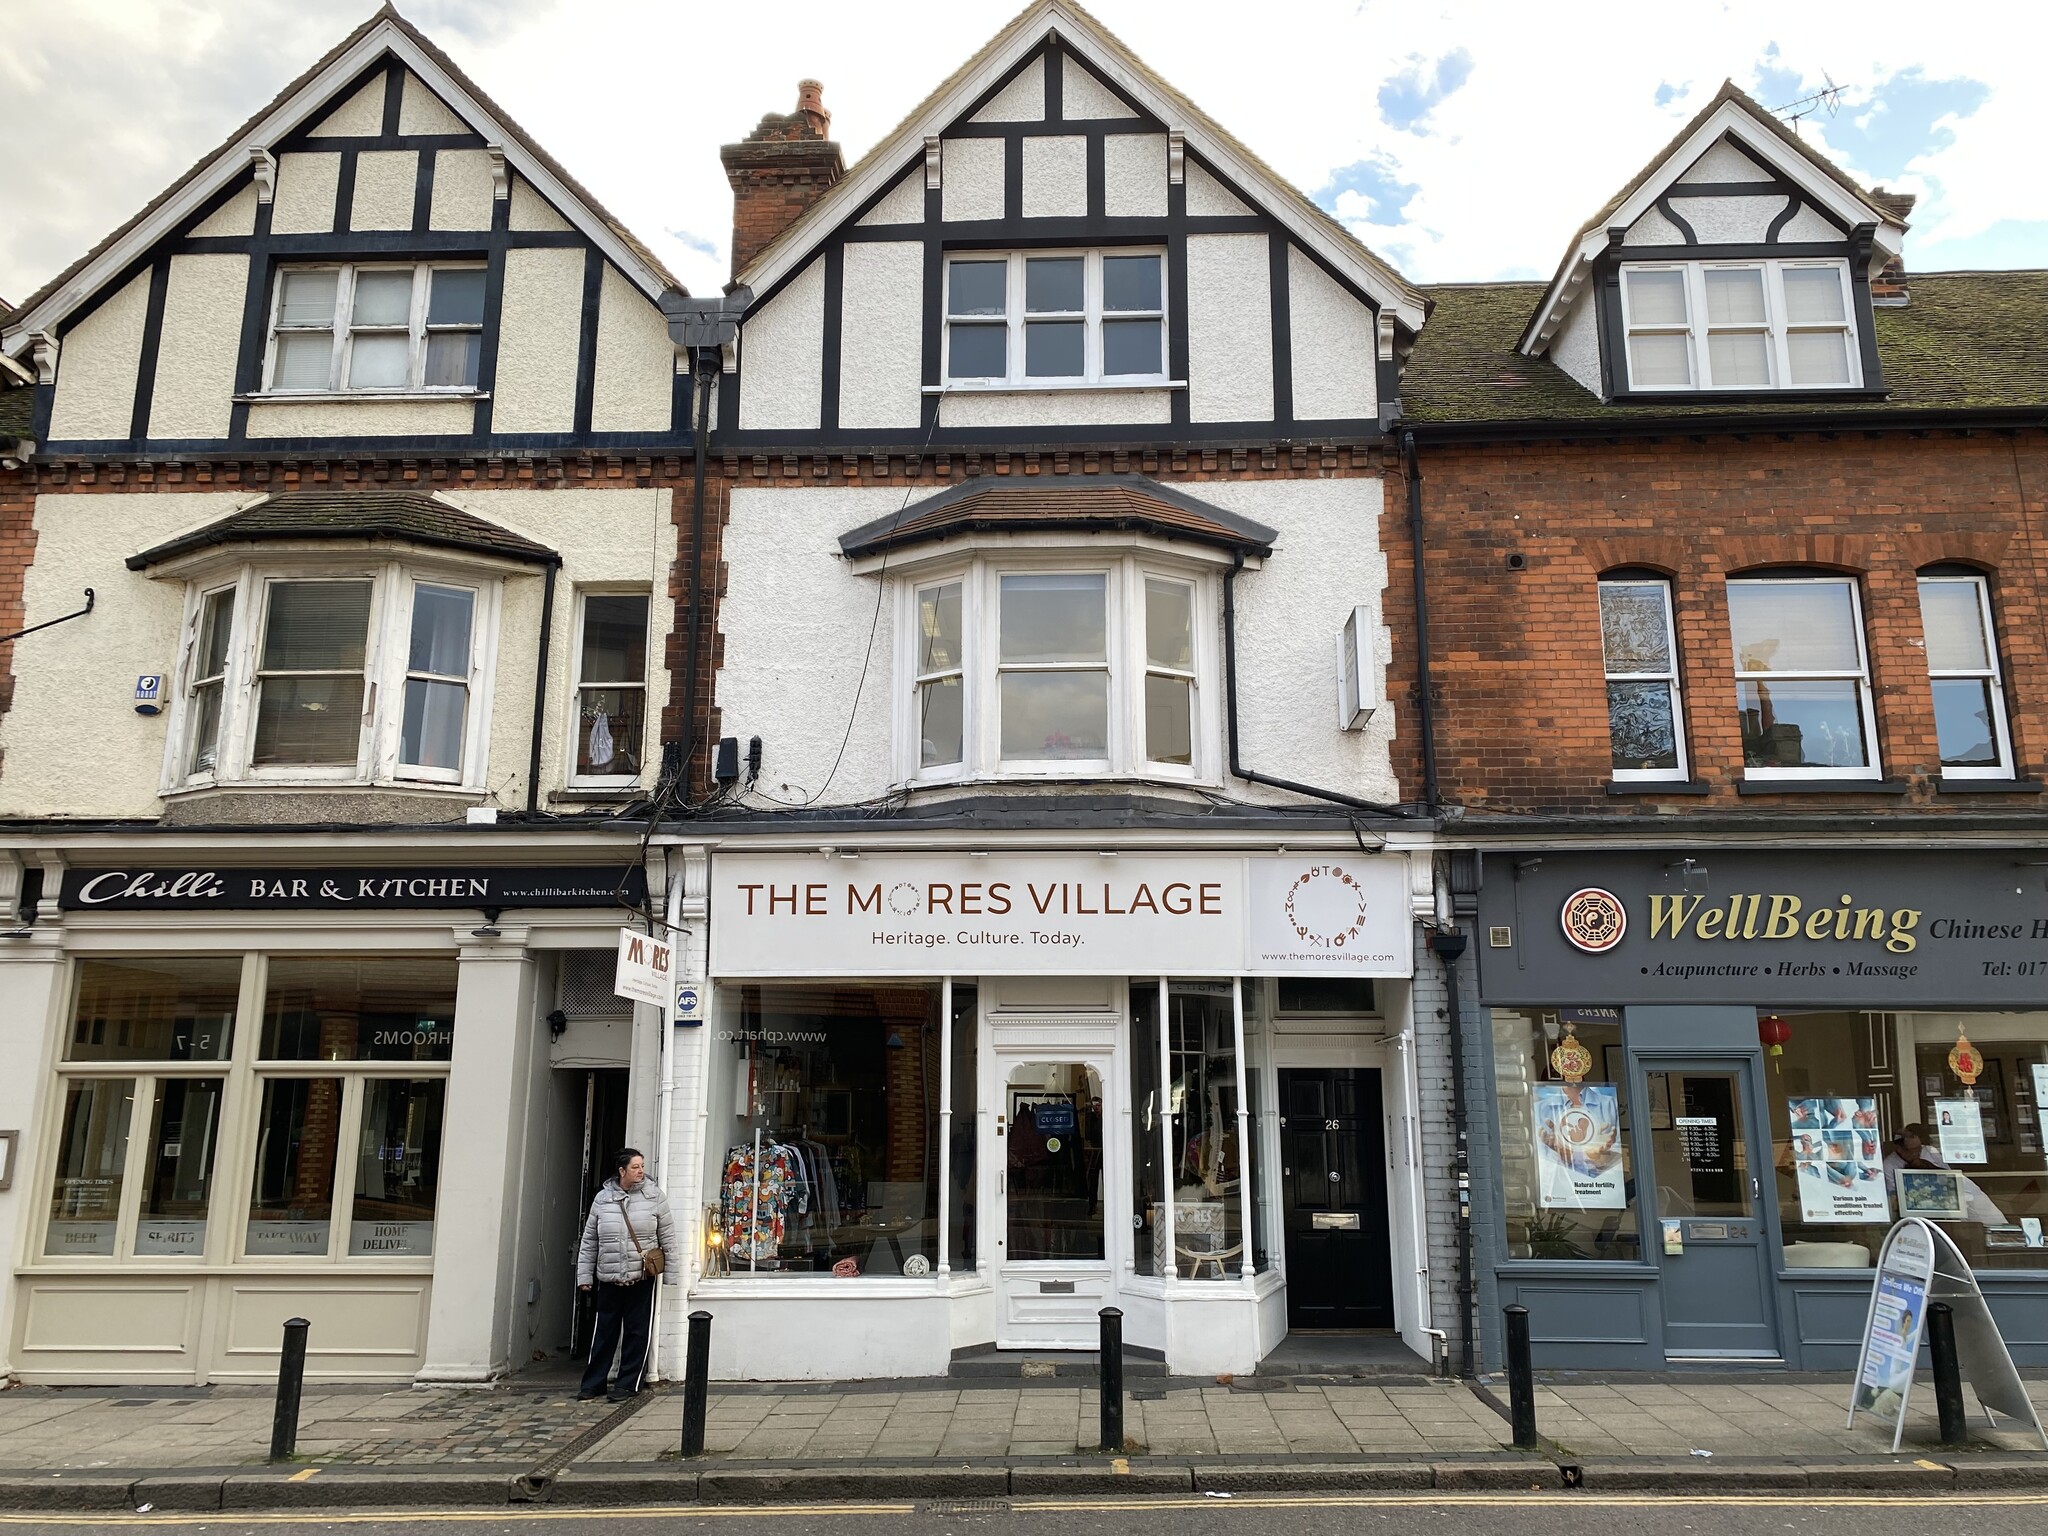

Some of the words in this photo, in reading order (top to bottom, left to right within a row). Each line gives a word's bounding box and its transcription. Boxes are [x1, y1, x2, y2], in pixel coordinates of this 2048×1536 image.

[78, 871, 226, 904] Chilli
[249, 879, 310, 898] BAR
[320, 880, 354, 901] &
[357, 878, 489, 898] KITCHEN
[503, 886, 629, 897] www.chillibarkitchen.cm
[738, 884, 828, 916] THE
[1027, 882, 1222, 915] VILLAGE
[1648, 893, 1922, 953] WellBeing
[1929, 918, 2023, 939] Chinese
[872, 931, 951, 948] Heritage.
[957, 931, 1025, 945] Culture.
[1030, 931, 1086, 948] Today.
[1261, 952, 1395, 963] www.themoresvillage.com
[1652, 961, 1759, 978] Acupuncture
[1777, 961, 1827, 976] Herbs
[1846, 961, 1919, 978] Massage
[1982, 961, 2012, 976] Tel:
[678, 997, 697, 1005] AFS
[1325, 1119, 1340, 1130] 26
[64, 1232, 98, 1244] BEER
[374, 1226, 409, 1237] HOME
[1730, 1226, 1748, 1239] 24
